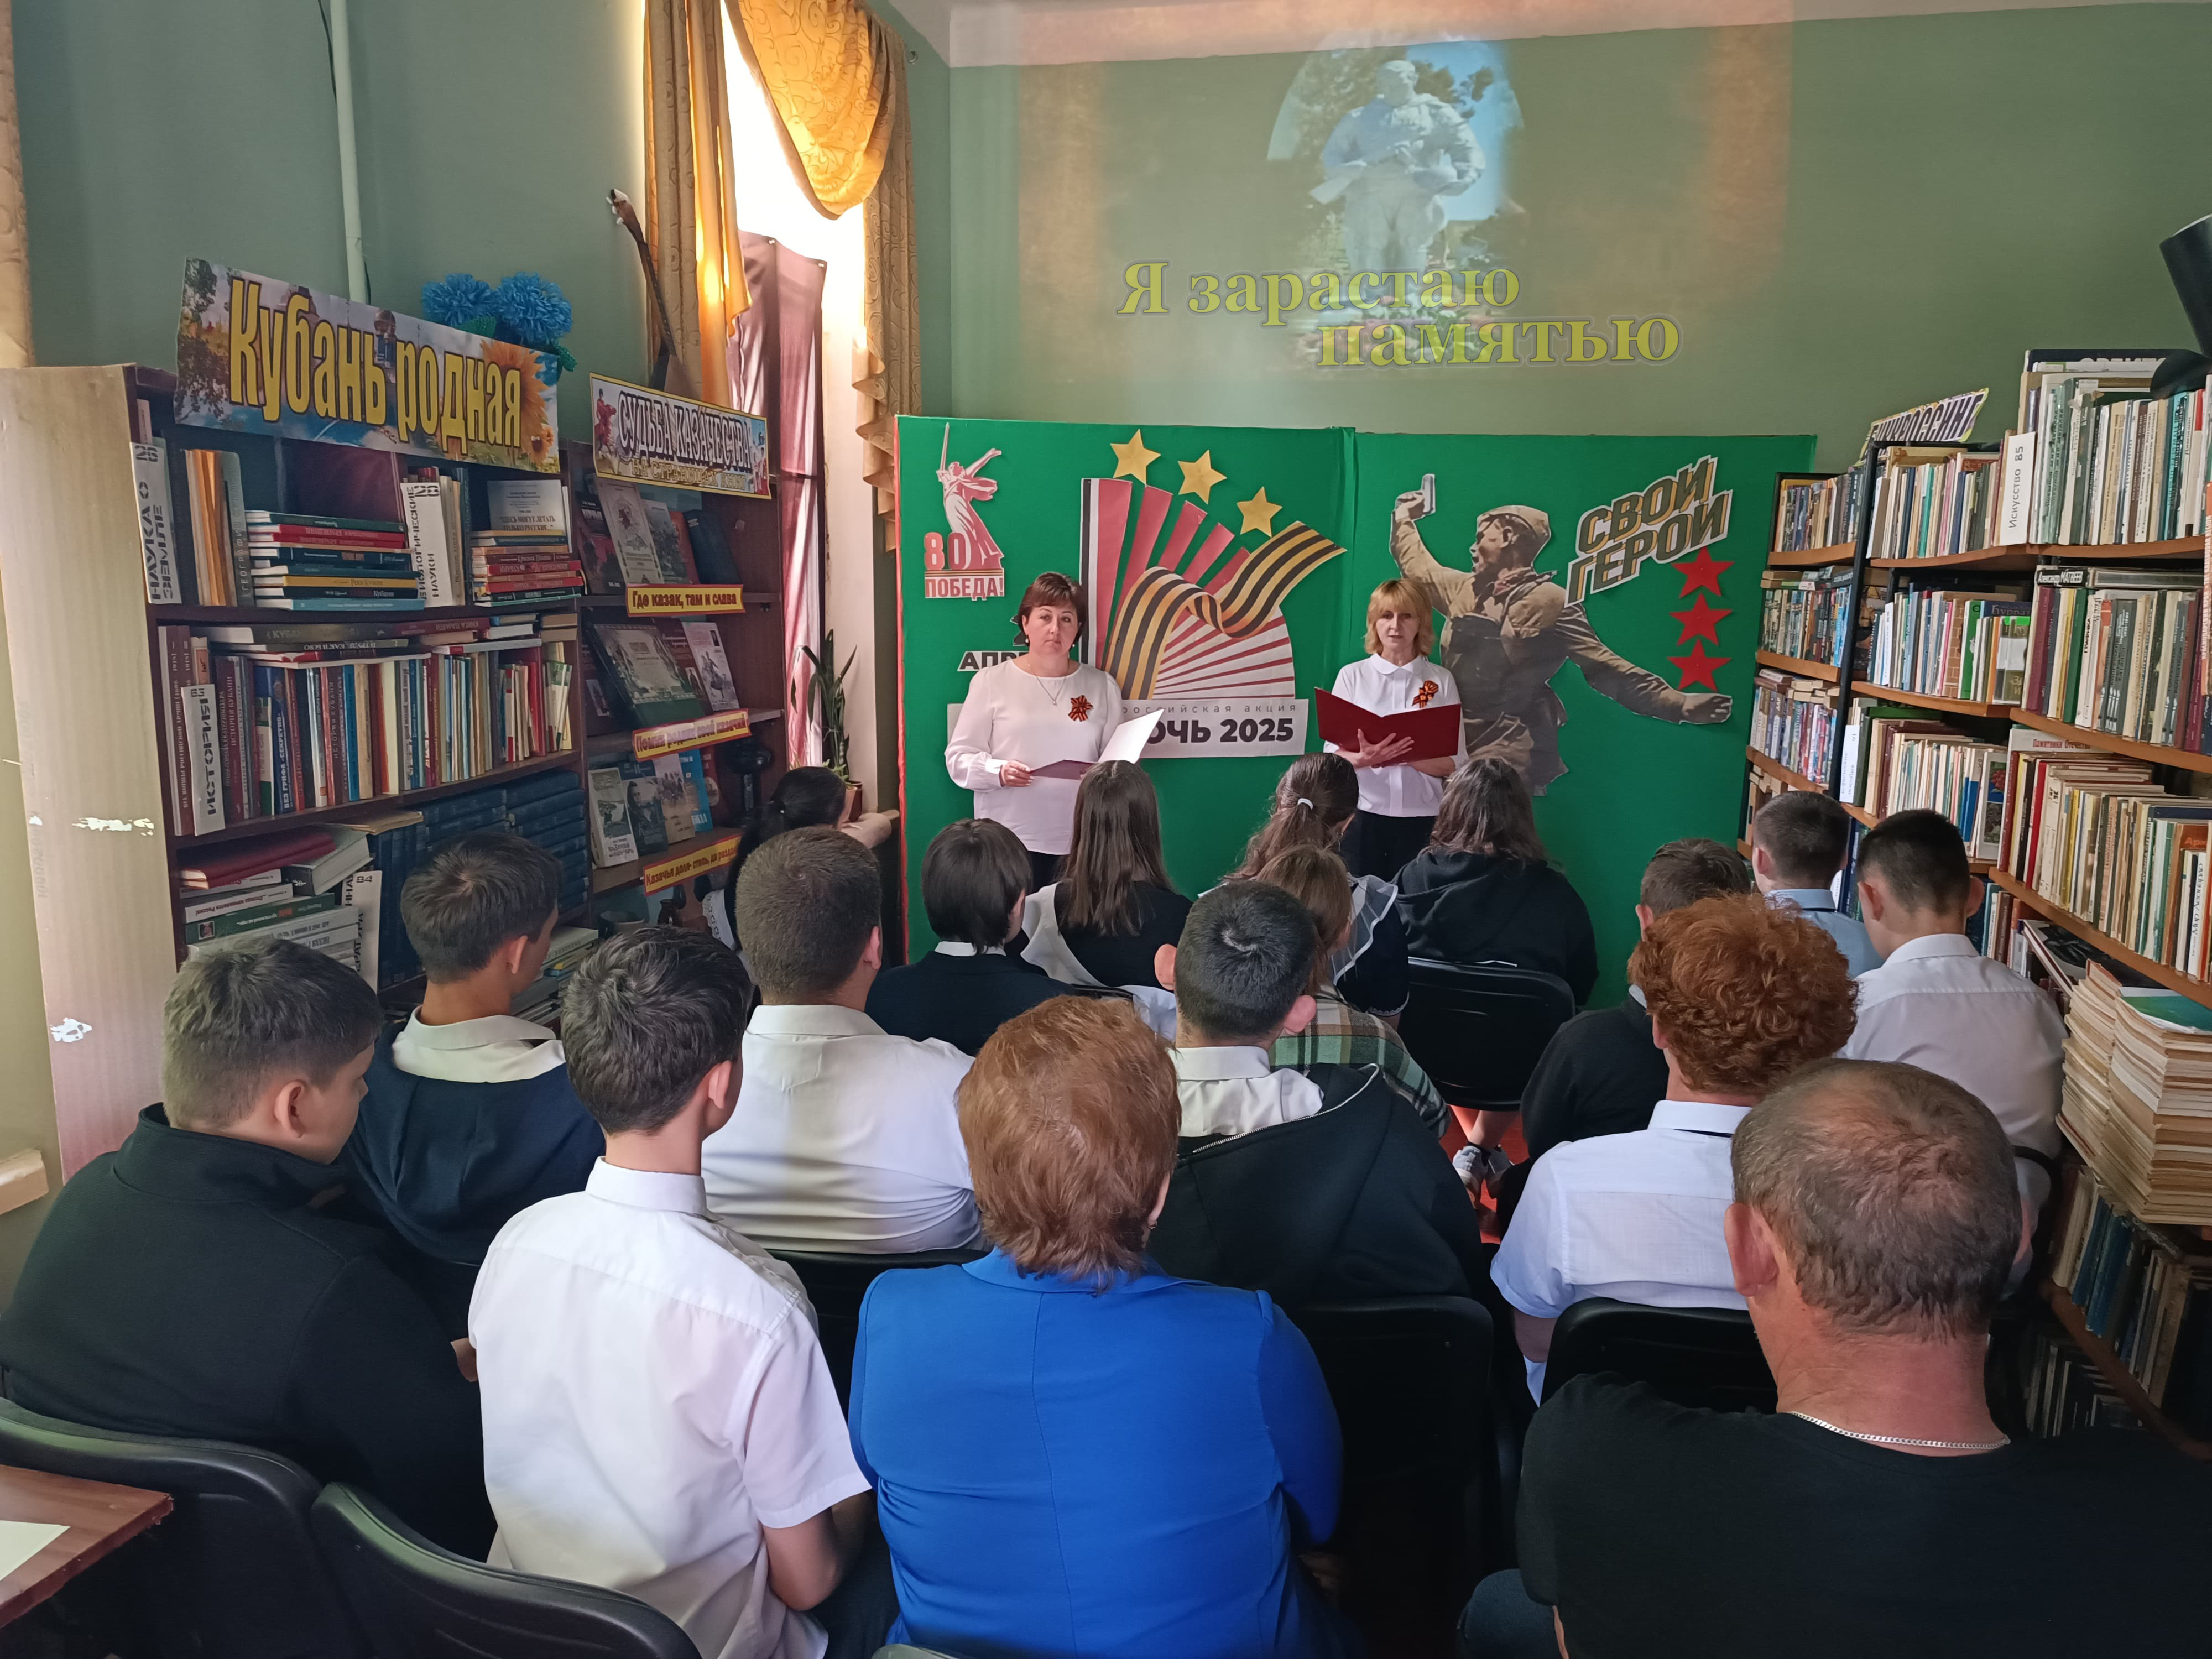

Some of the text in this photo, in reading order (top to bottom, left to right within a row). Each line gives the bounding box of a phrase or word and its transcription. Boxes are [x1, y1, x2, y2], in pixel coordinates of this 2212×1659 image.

[1117, 262, 1520, 326] Я зарастаю
[230, 278, 521, 455] Кубань родная
[1316, 316, 1681, 367] памятью
[618, 392, 752, 473] СУДЬБА КАЗАЧЕСТВА
[414, 485, 439, 497] 28
[632, 459, 649, 476] НА
[2008, 446, 2023, 528] Искусство 85
[1579, 458, 1713, 555] СВОИ
[141, 505, 161, 600] НАУКА
[153, 504, 173, 599] ЗЕМЛЕ
[1567, 494, 1729, 603] ГЕРОИ
[427, 554, 439, 597] НАУКИ
[632, 591, 649, 608] Где
[652, 592, 684, 609] казак,
[686, 593, 703, 606] там
[712, 592, 737, 605] слава
[926, 576, 1003, 601] ПОБЕДА!
[191, 688, 205, 697] 63
[1244, 705, 1296, 714] акция
[200, 698, 216, 815] ИСТОРИЯ
[1147, 718, 1294, 744] ОЧЬ 2025
[646, 868, 674, 886] Казачья
